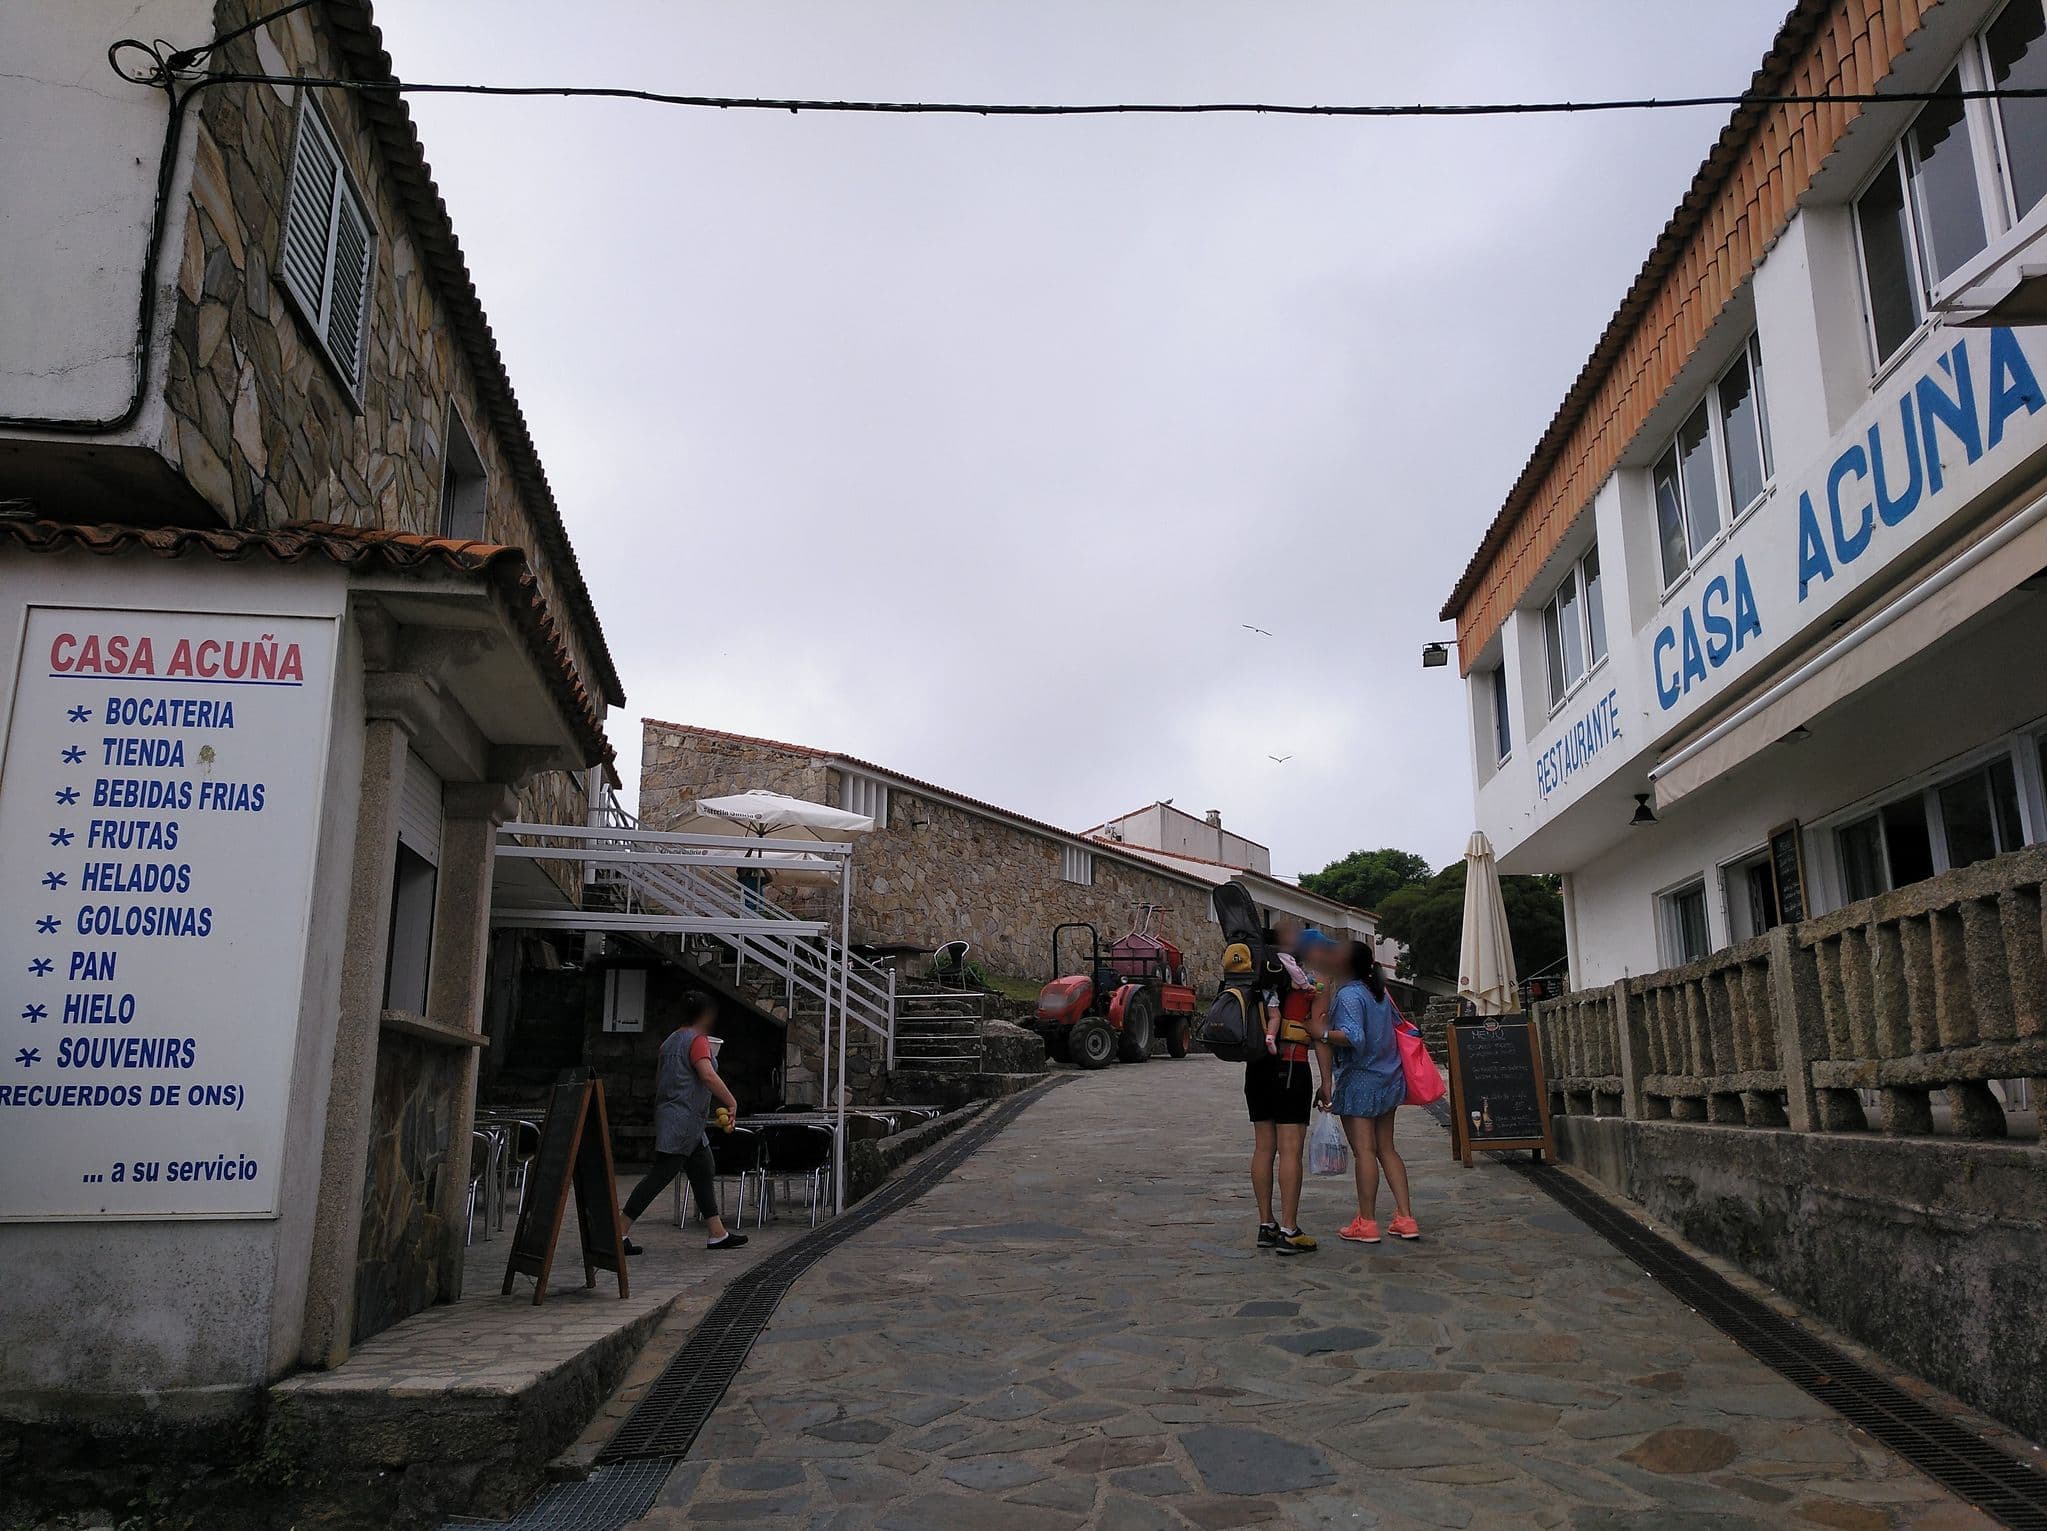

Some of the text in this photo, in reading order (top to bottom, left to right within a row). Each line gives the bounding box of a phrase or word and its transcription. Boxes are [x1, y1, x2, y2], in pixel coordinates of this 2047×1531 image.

[1653, 553, 1762, 711] CASA
[51, 633, 304, 681] CASA ACUÑA
[105, 697, 234, 729] BOCATERIA
[102, 737, 185, 768] TIENDA
[1536, 688, 1620, 799] RESTAURANTE
[93, 778, 265, 812] BEBIDAS FRIAS
[88, 819, 179, 850] FRUTAS
[82, 862, 191, 893] HELADOS
[77, 905, 213, 937] GOLOSINAS
[68, 951, 117, 981] PAN
[62, 993, 136, 1025] HIELO
[56, 1037, 196, 1069] SOUVENIRS
[150, 1085, 181, 1106] DE
[187, 1084, 245, 1111] ONS)
[132, 1162, 160, 1182] su
[166, 1153, 258, 1182] servicio
